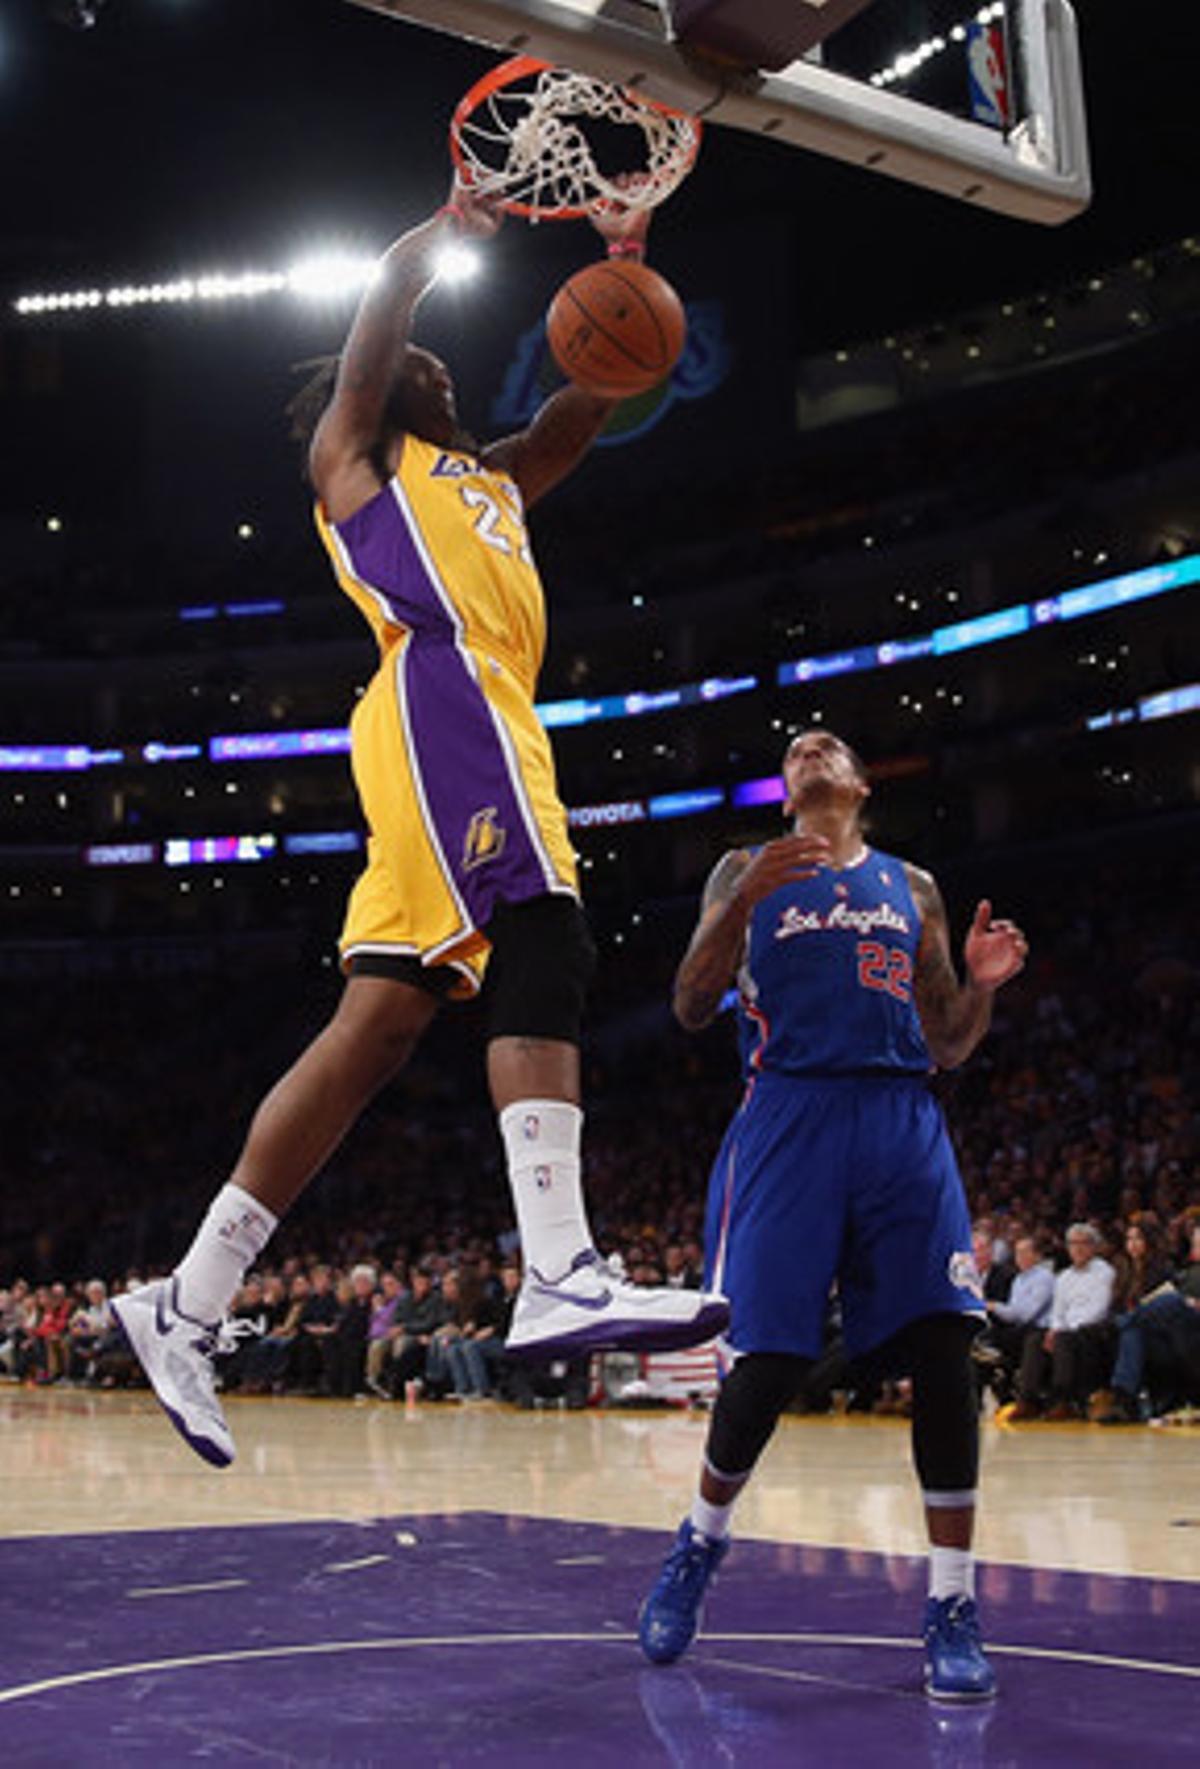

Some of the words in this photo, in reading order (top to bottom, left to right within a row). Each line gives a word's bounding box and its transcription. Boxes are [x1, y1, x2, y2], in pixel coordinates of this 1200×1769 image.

[774, 905, 821, 939] Los
[827, 902, 909, 935] Angeles
[857, 941, 912, 1003] 22
